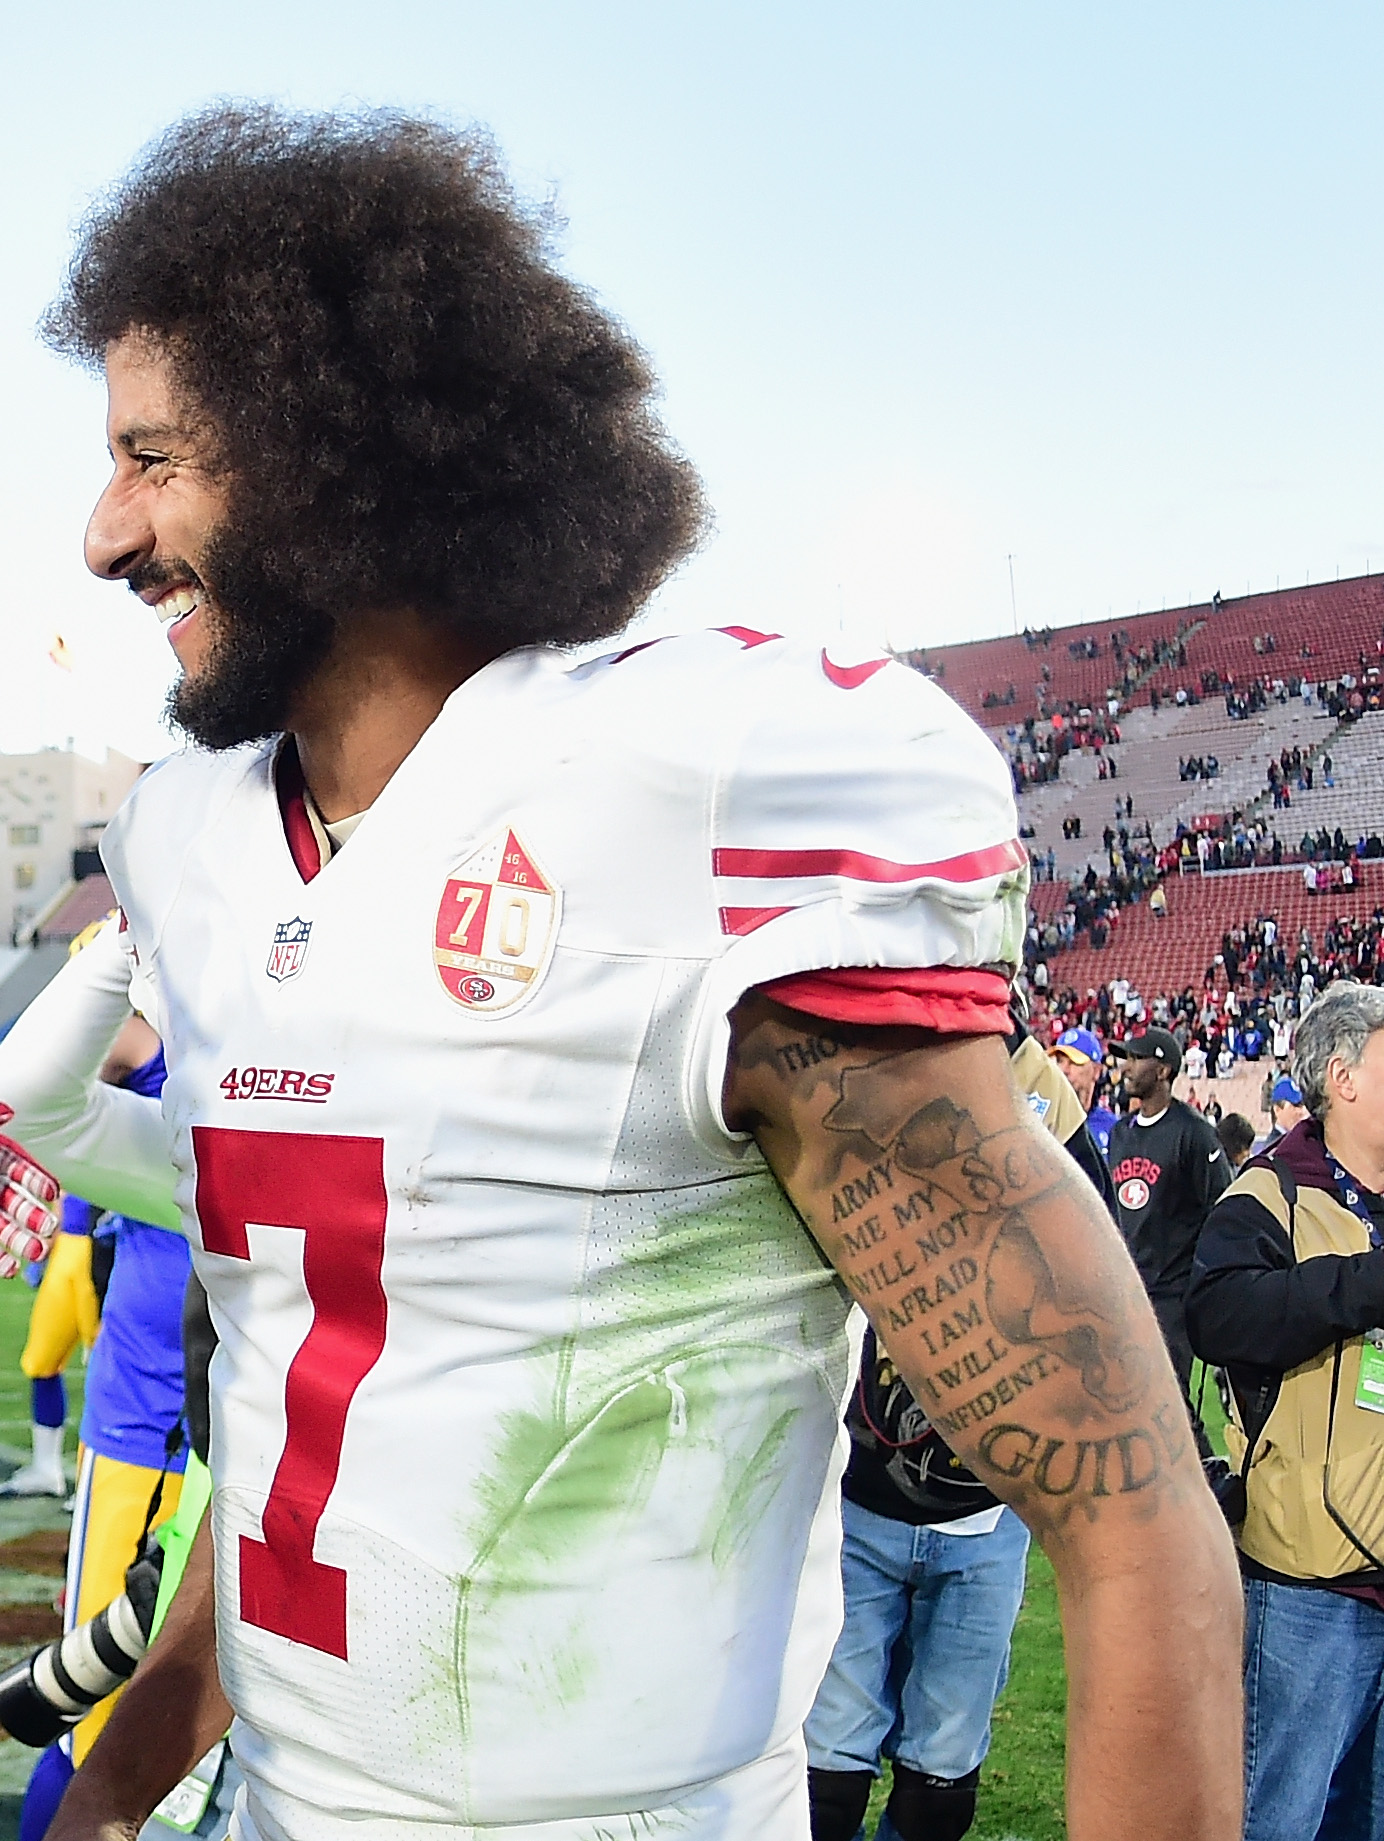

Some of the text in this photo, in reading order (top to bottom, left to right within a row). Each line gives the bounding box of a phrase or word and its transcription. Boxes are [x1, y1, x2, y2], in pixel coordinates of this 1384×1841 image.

[270, 944, 301, 976] NFL
[451, 953, 516, 974] YEARS
[219, 1066, 335, 1103] 49ERS
[830, 1158, 894, 1223] ARMY
[1112, 1157, 1161, 1185] 49ERS
[840, 1182, 938, 1257] ME MY
[916, 1210, 970, 1262] NOT
[938, 1299, 984, 1347] AM
[935, 1337, 1008, 1389] WILL
[190, 1125, 387, 1663] 7
[978, 1402, 1186, 1496] GUIDE
